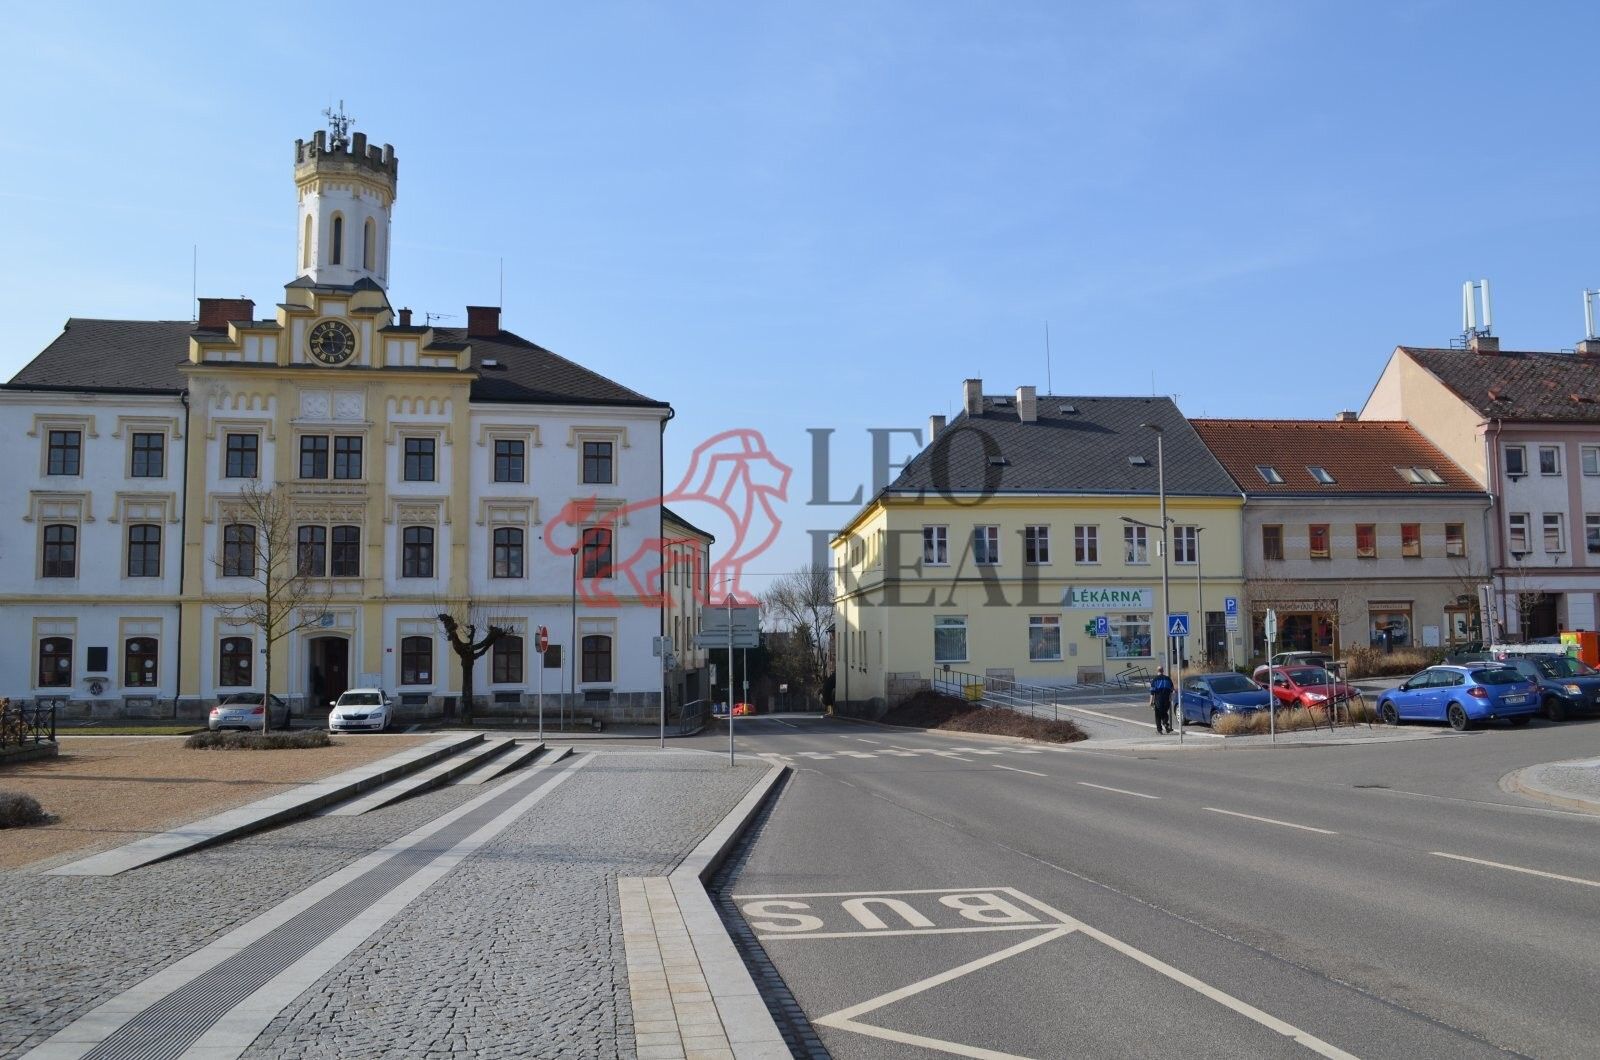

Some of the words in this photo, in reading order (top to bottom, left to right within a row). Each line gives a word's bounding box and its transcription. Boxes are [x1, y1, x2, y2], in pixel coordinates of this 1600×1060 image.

[1072, 588, 1142, 603] LÉKÁRNA
[1227, 599, 1235, 611] P
[1098, 618, 1106, 629] P
[742, 893, 1042, 932] BUS
